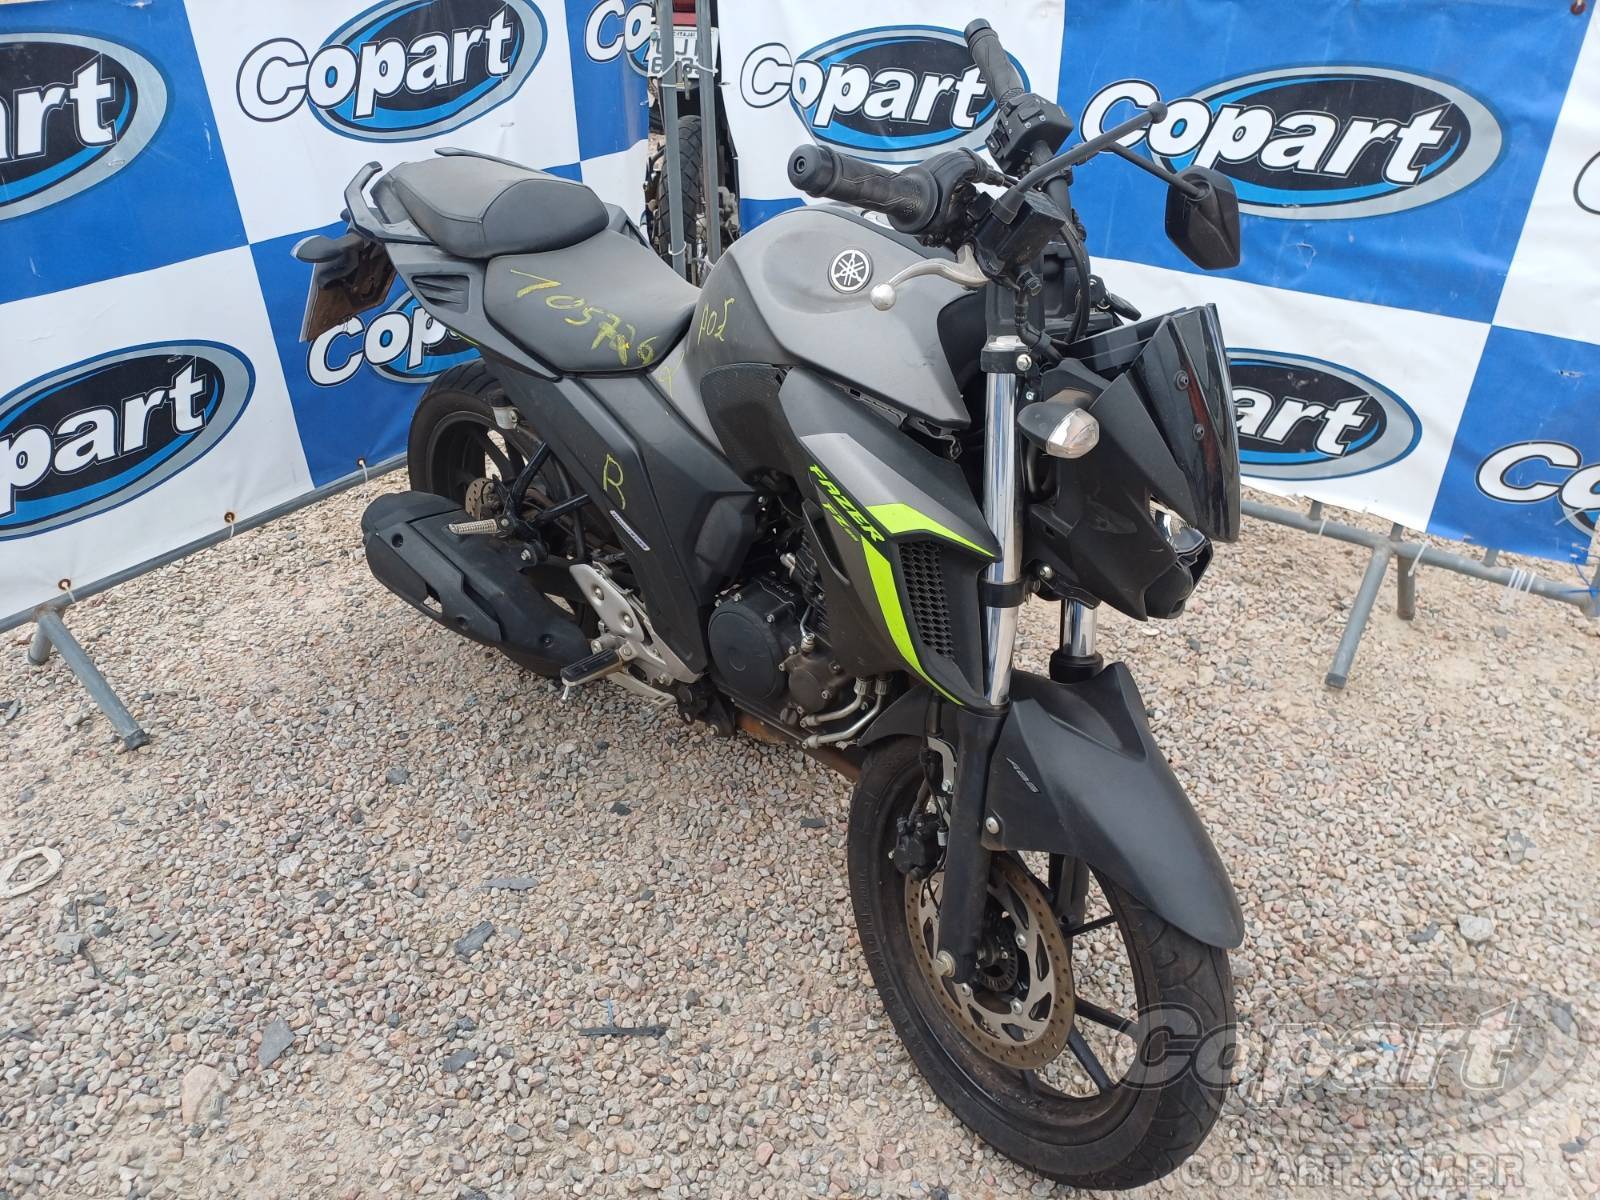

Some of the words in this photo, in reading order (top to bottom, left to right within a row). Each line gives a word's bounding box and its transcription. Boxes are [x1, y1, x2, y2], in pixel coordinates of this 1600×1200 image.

[235, 2, 514, 122] Copart
[584, 0, 655, 63] Co
[740, 42, 992, 129] Copart
[1080, 79, 1454, 188] Copart
[306, 303, 462, 388] Cop
[809, 463, 885, 542] FAZER
